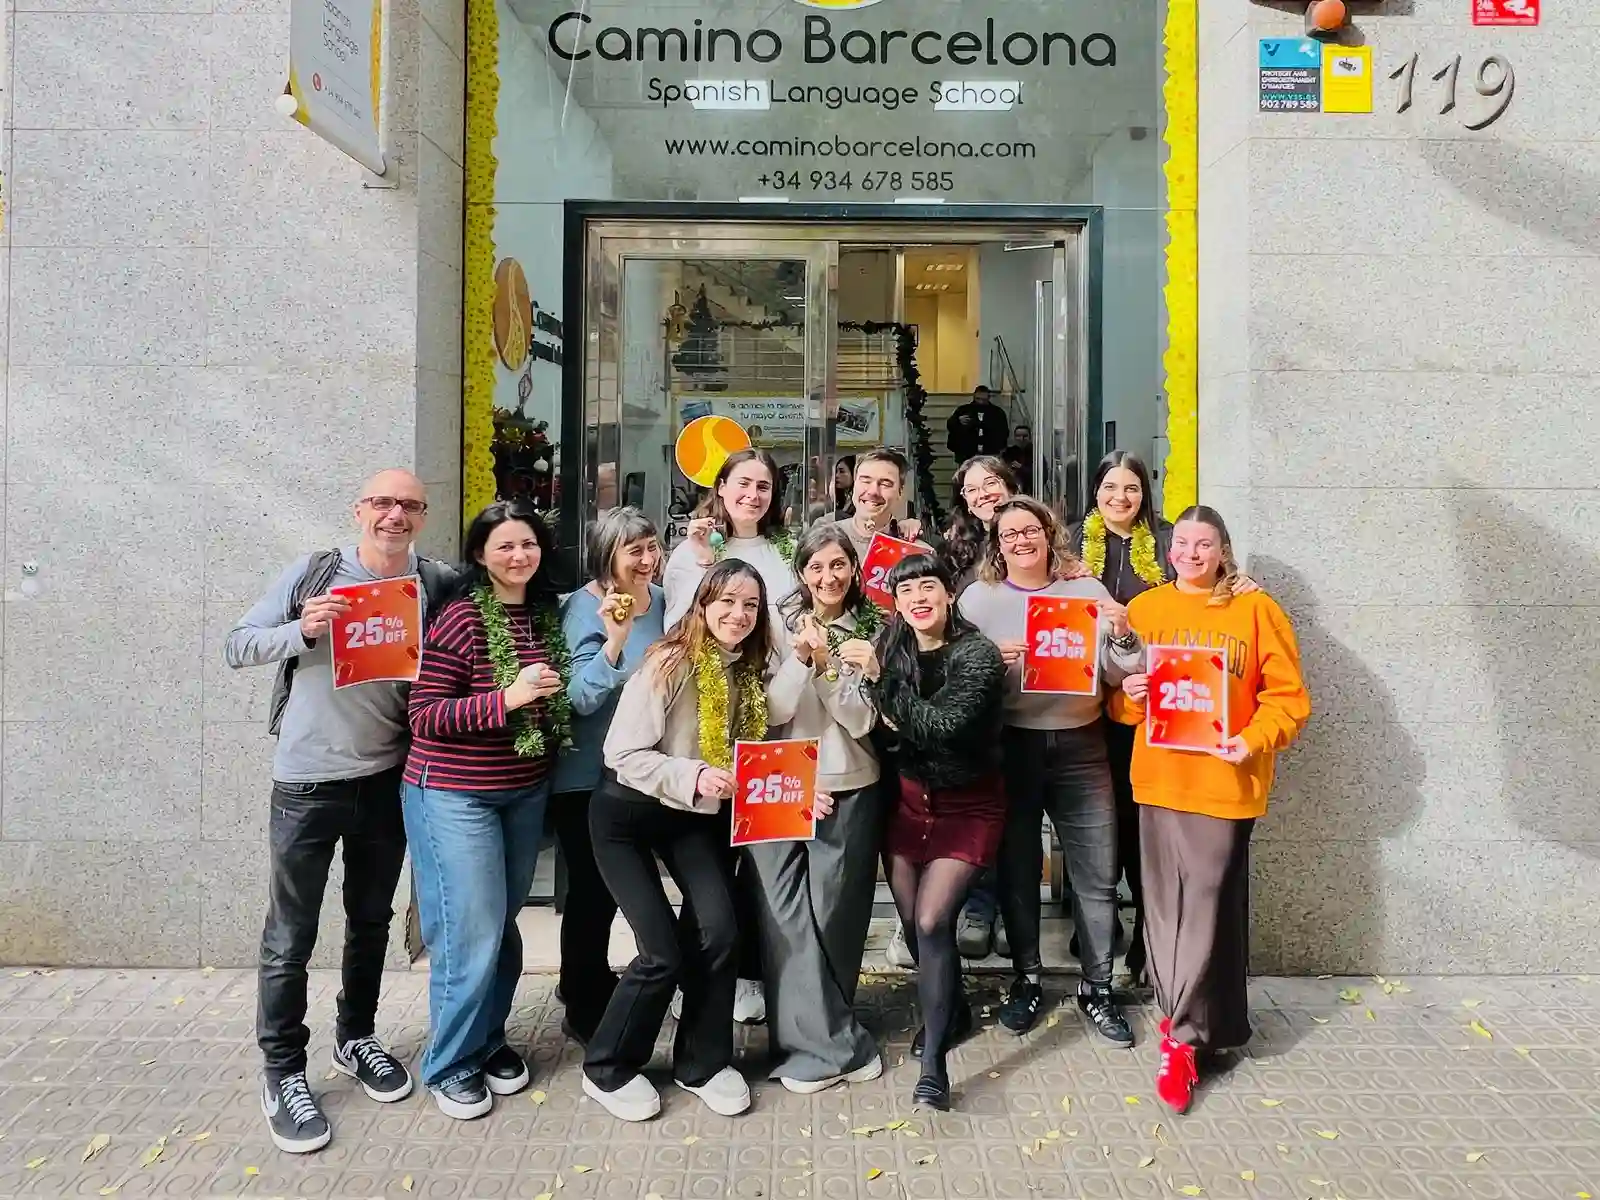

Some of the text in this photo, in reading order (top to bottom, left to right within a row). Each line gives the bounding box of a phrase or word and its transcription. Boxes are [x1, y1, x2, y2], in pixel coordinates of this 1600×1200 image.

[547, 12, 1117, 67] Camino Barcelona
[648, 78, 1024, 110] Spanish Language School
[1388, 52, 1516, 131] 119
[1260, 100, 1280, 109] 902
[665, 135, 1036, 159] www.caminobarcelona.com
[757, 171, 954, 192] +34 934 678 585
[385, 628, 408, 644] OFF
[782, 791, 805, 804] OFF
